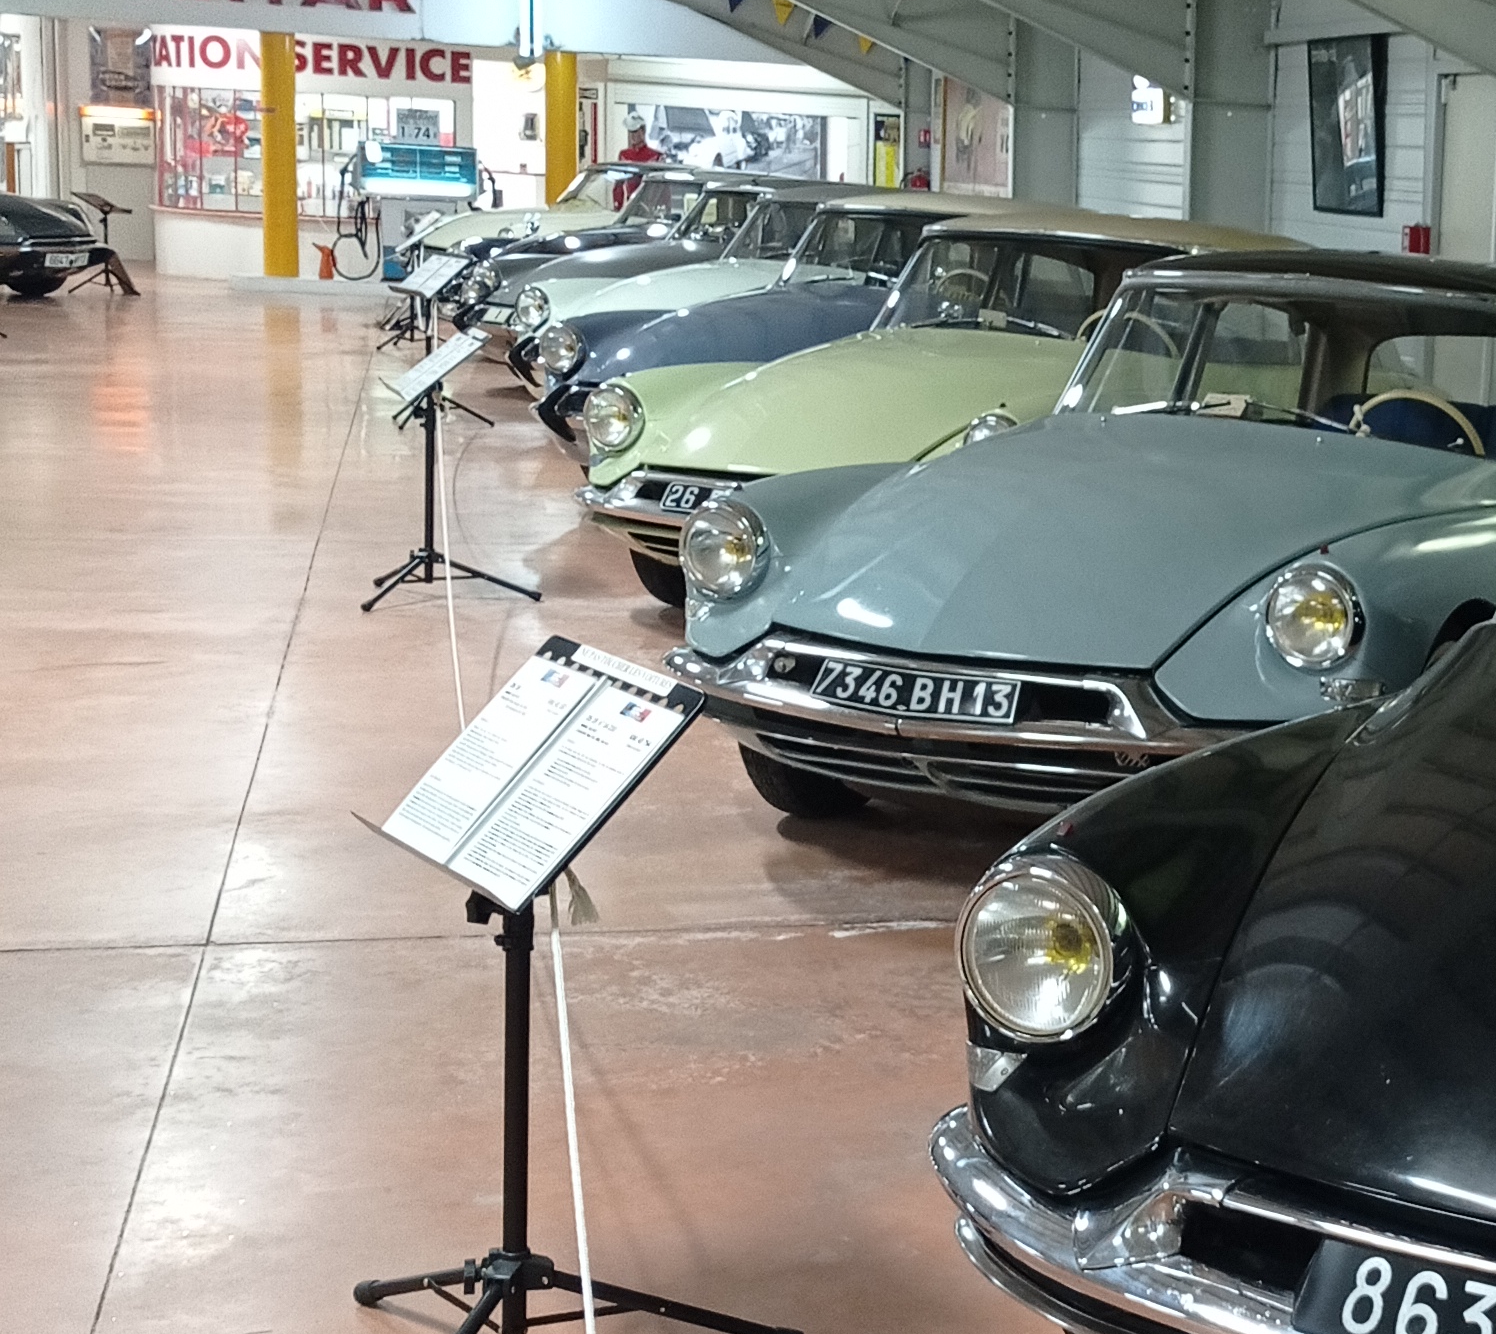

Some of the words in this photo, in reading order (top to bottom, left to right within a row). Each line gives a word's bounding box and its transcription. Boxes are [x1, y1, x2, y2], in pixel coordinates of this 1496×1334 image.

[151, 34, 262, 70] ATION
[294, 38, 471, 85] SERVICE
[664, 485, 700, 509] 26
[815, 662, 903, 708] 7346
[909, 677, 965, 715] BH
[972, 681, 1013, 717] 13
